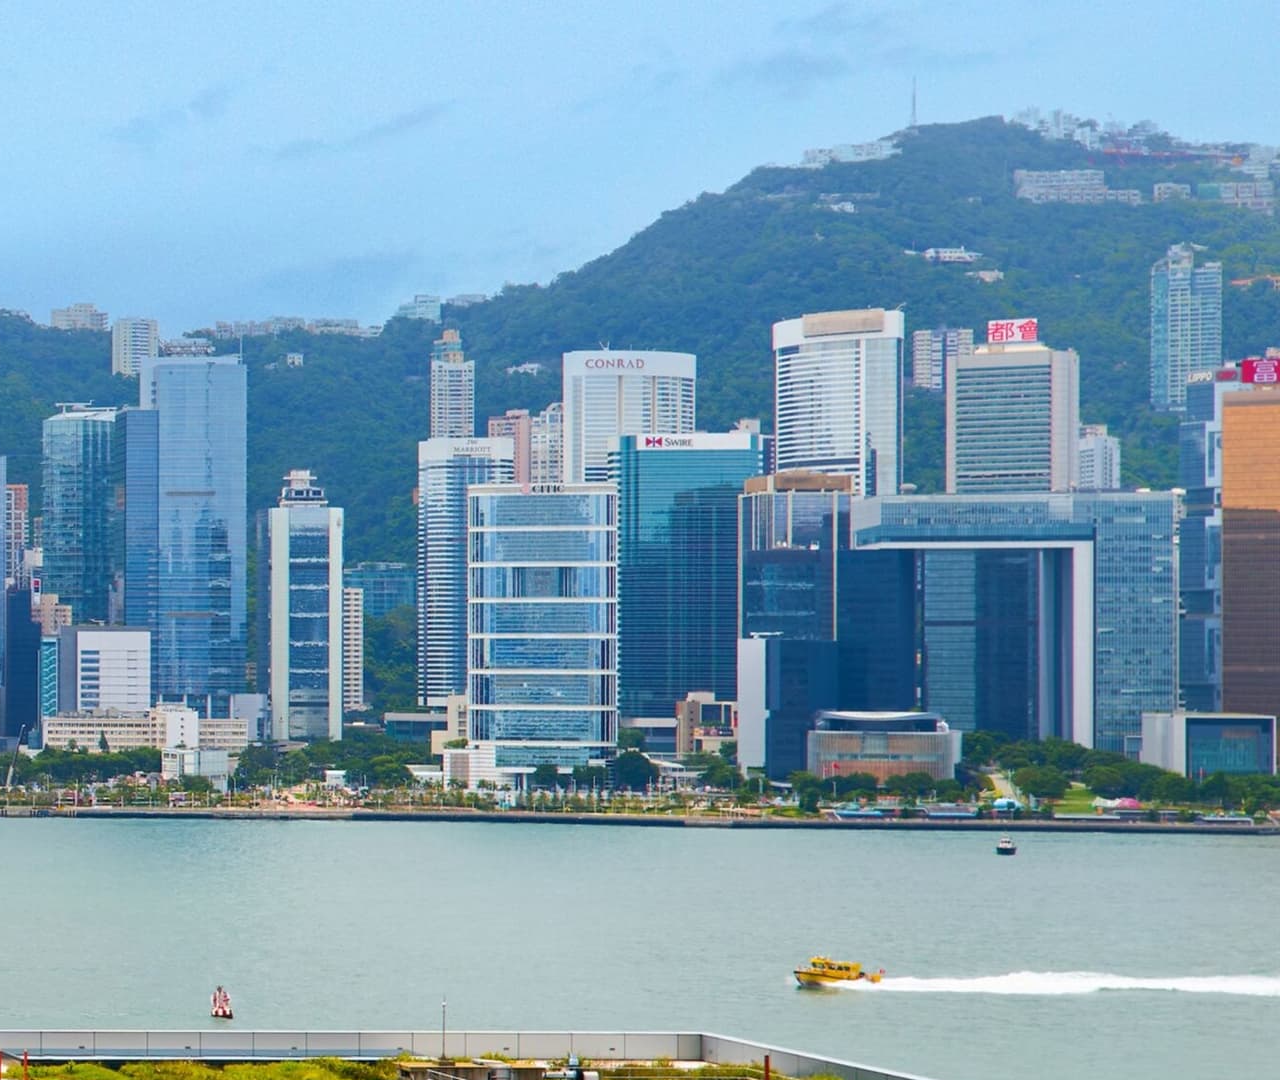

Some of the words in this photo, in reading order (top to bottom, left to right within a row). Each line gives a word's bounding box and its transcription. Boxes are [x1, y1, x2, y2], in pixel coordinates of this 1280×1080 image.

[988, 319, 1038, 341] 都會
[585, 358, 645, 369] CONRAD
[1252, 360, 1279, 383] 富
[532, 484, 565, 493] CITIC
